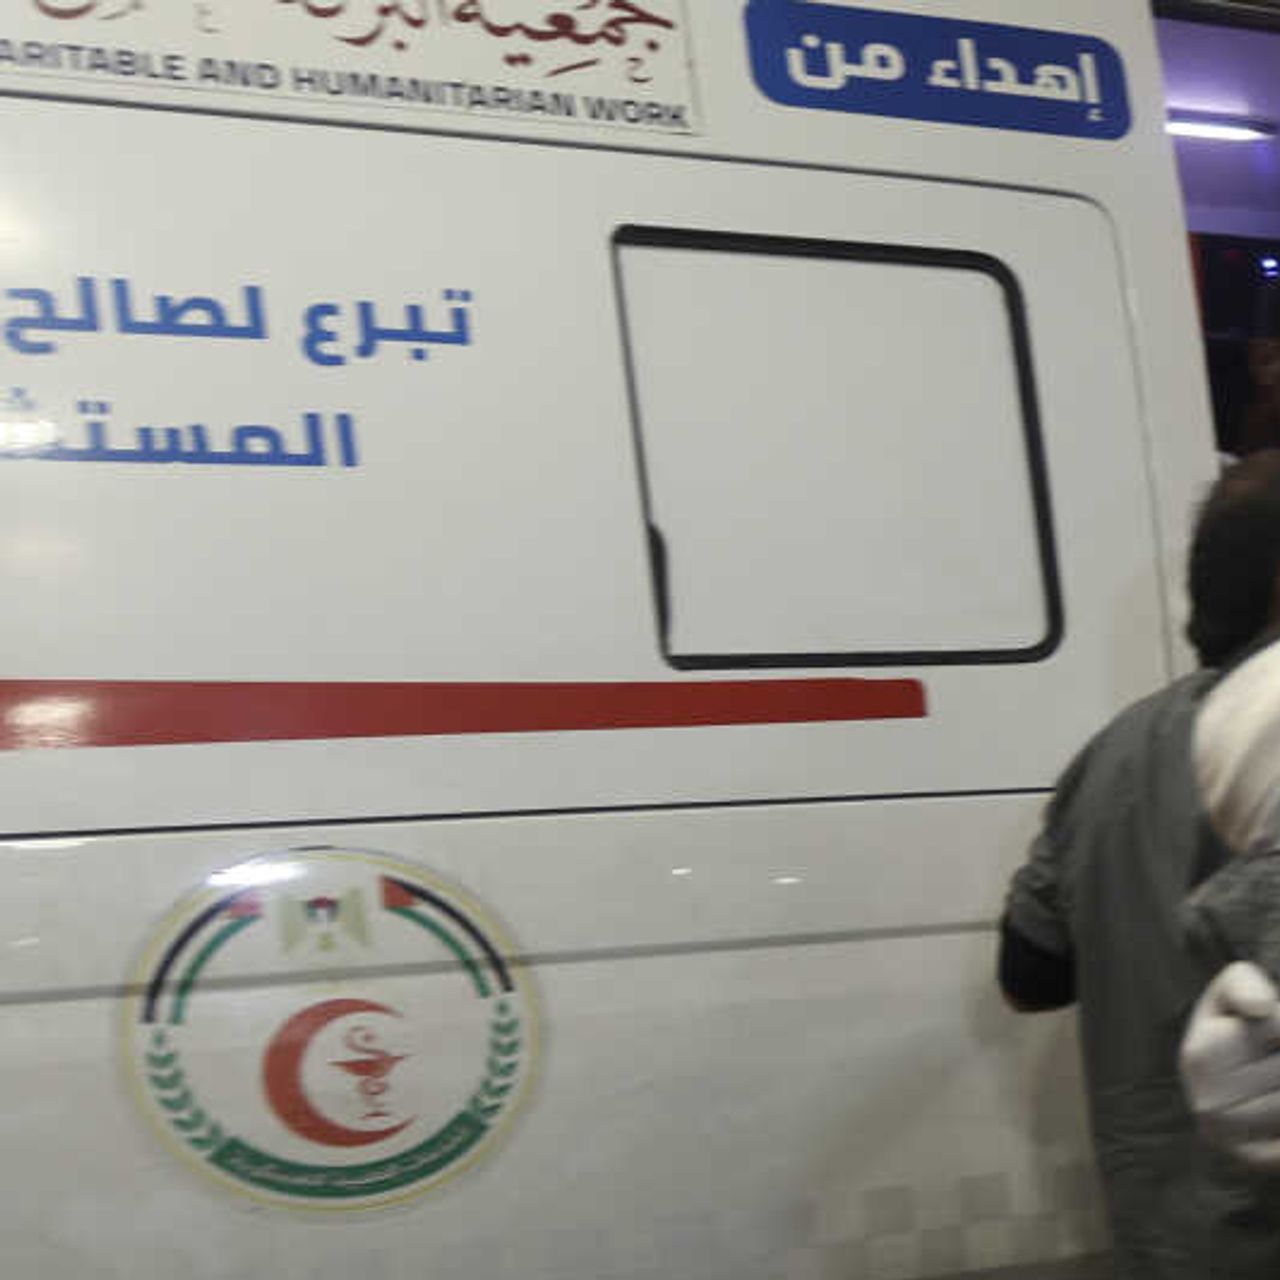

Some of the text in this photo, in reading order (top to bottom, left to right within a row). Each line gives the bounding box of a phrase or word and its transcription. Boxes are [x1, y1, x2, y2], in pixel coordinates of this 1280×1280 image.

[198, 56, 283, 90] AND
[292, 67, 578, 118] HUMANITARIAN
[582, 96, 690, 130] WORK
[786, 33, 1106, 122] إهداء من
[3, 276, 473, 366] تبرع لصالح
